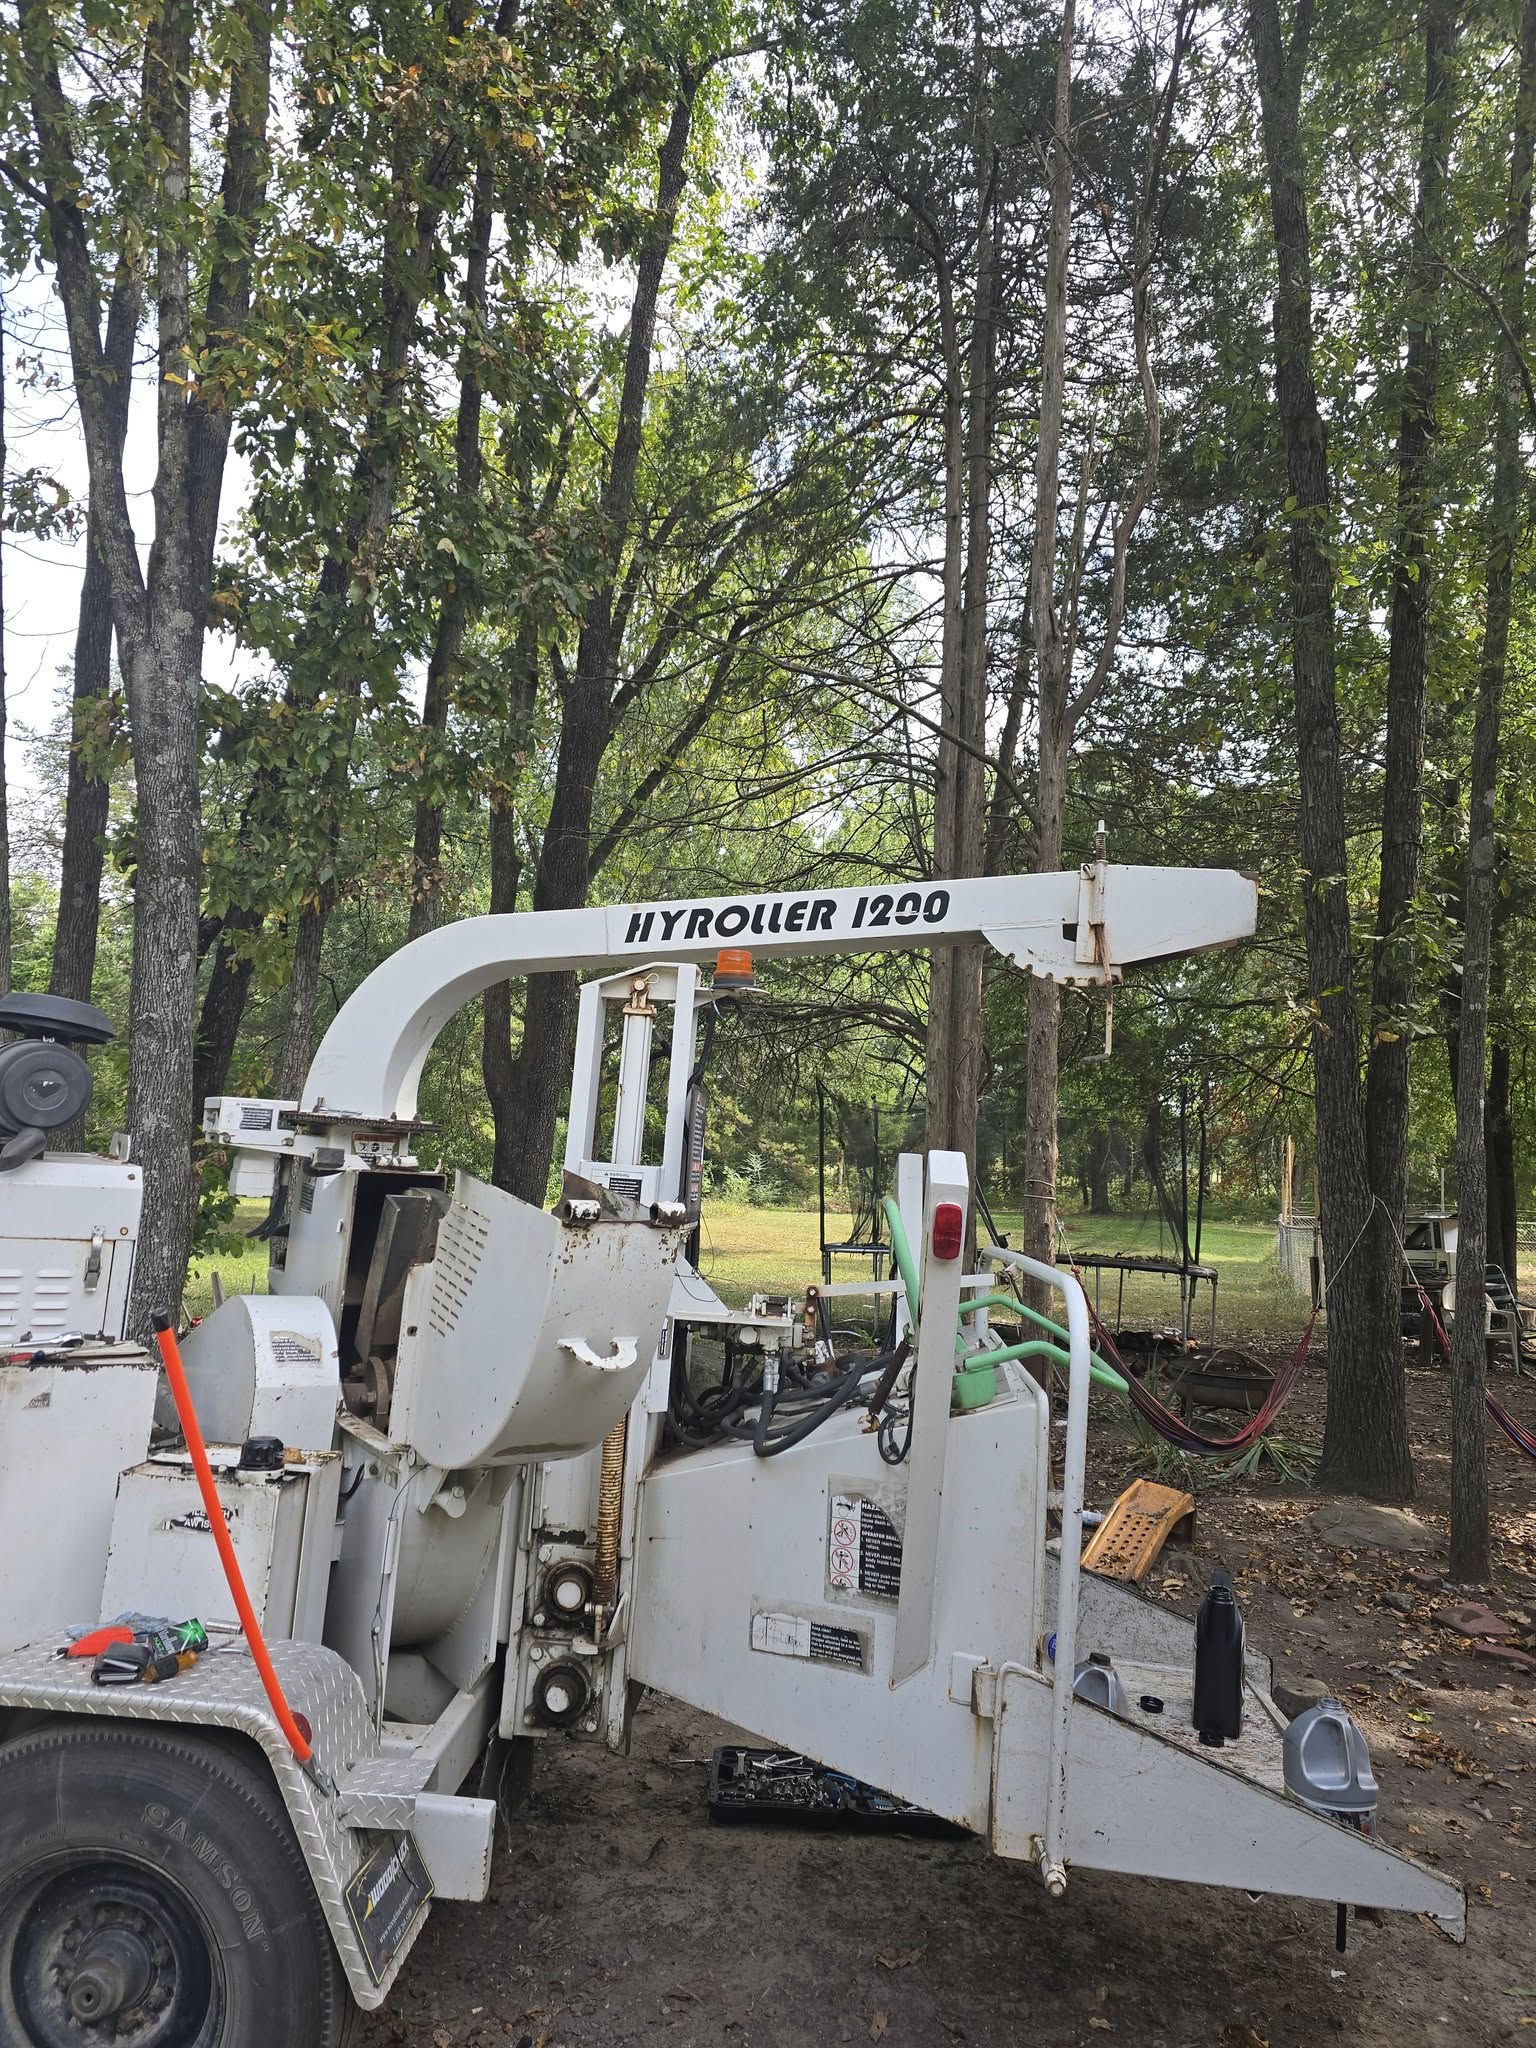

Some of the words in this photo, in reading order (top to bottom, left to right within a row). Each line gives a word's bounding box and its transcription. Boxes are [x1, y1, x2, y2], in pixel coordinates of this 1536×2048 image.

[624, 899, 837, 943] HYROLLER
[851, 890, 950, 929] 1200
[30, 1400, 49, 1409] ONLY
[138, 1802, 266, 1940] SAMSON
